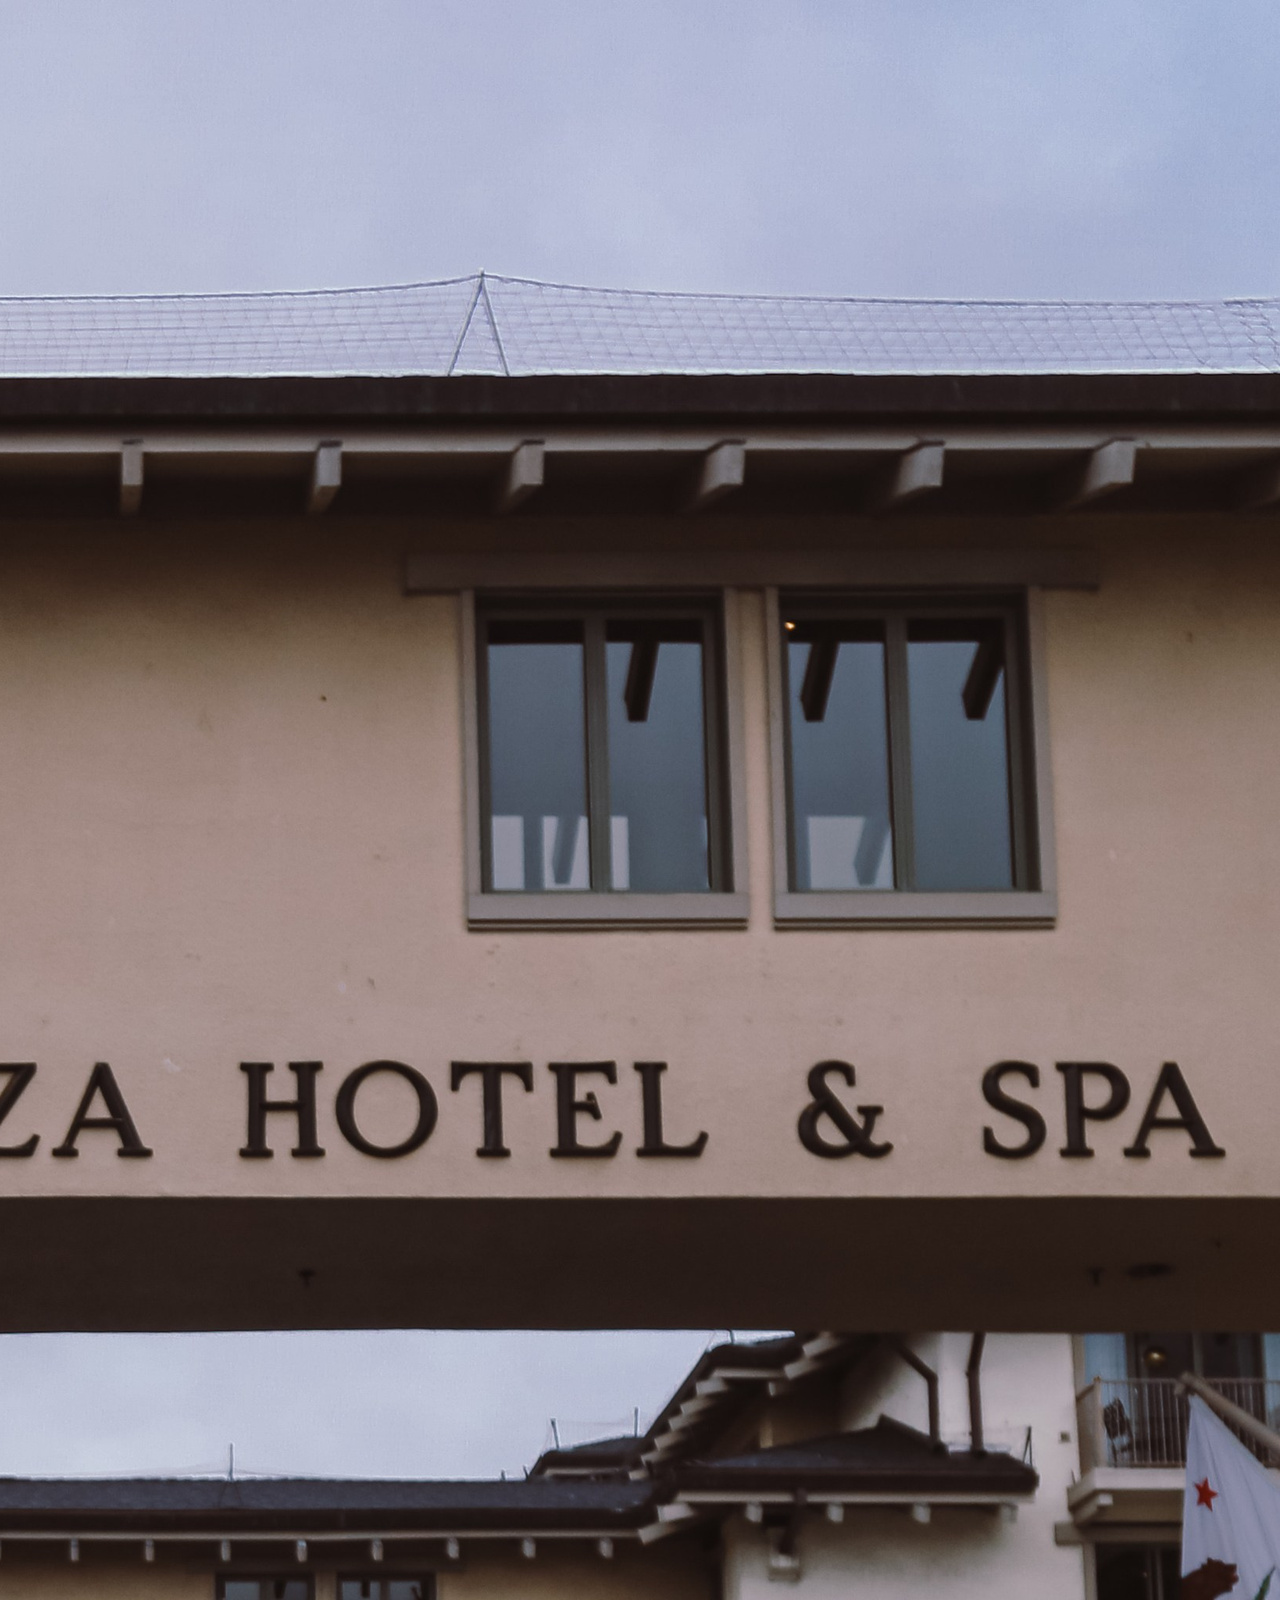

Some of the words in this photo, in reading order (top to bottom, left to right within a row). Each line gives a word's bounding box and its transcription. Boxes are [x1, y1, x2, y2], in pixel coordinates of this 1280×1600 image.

[239, 1060, 709, 1160] HOTEL
[797, 1060, 894, 1159] &
[983, 1060, 1226, 1160] SPA
